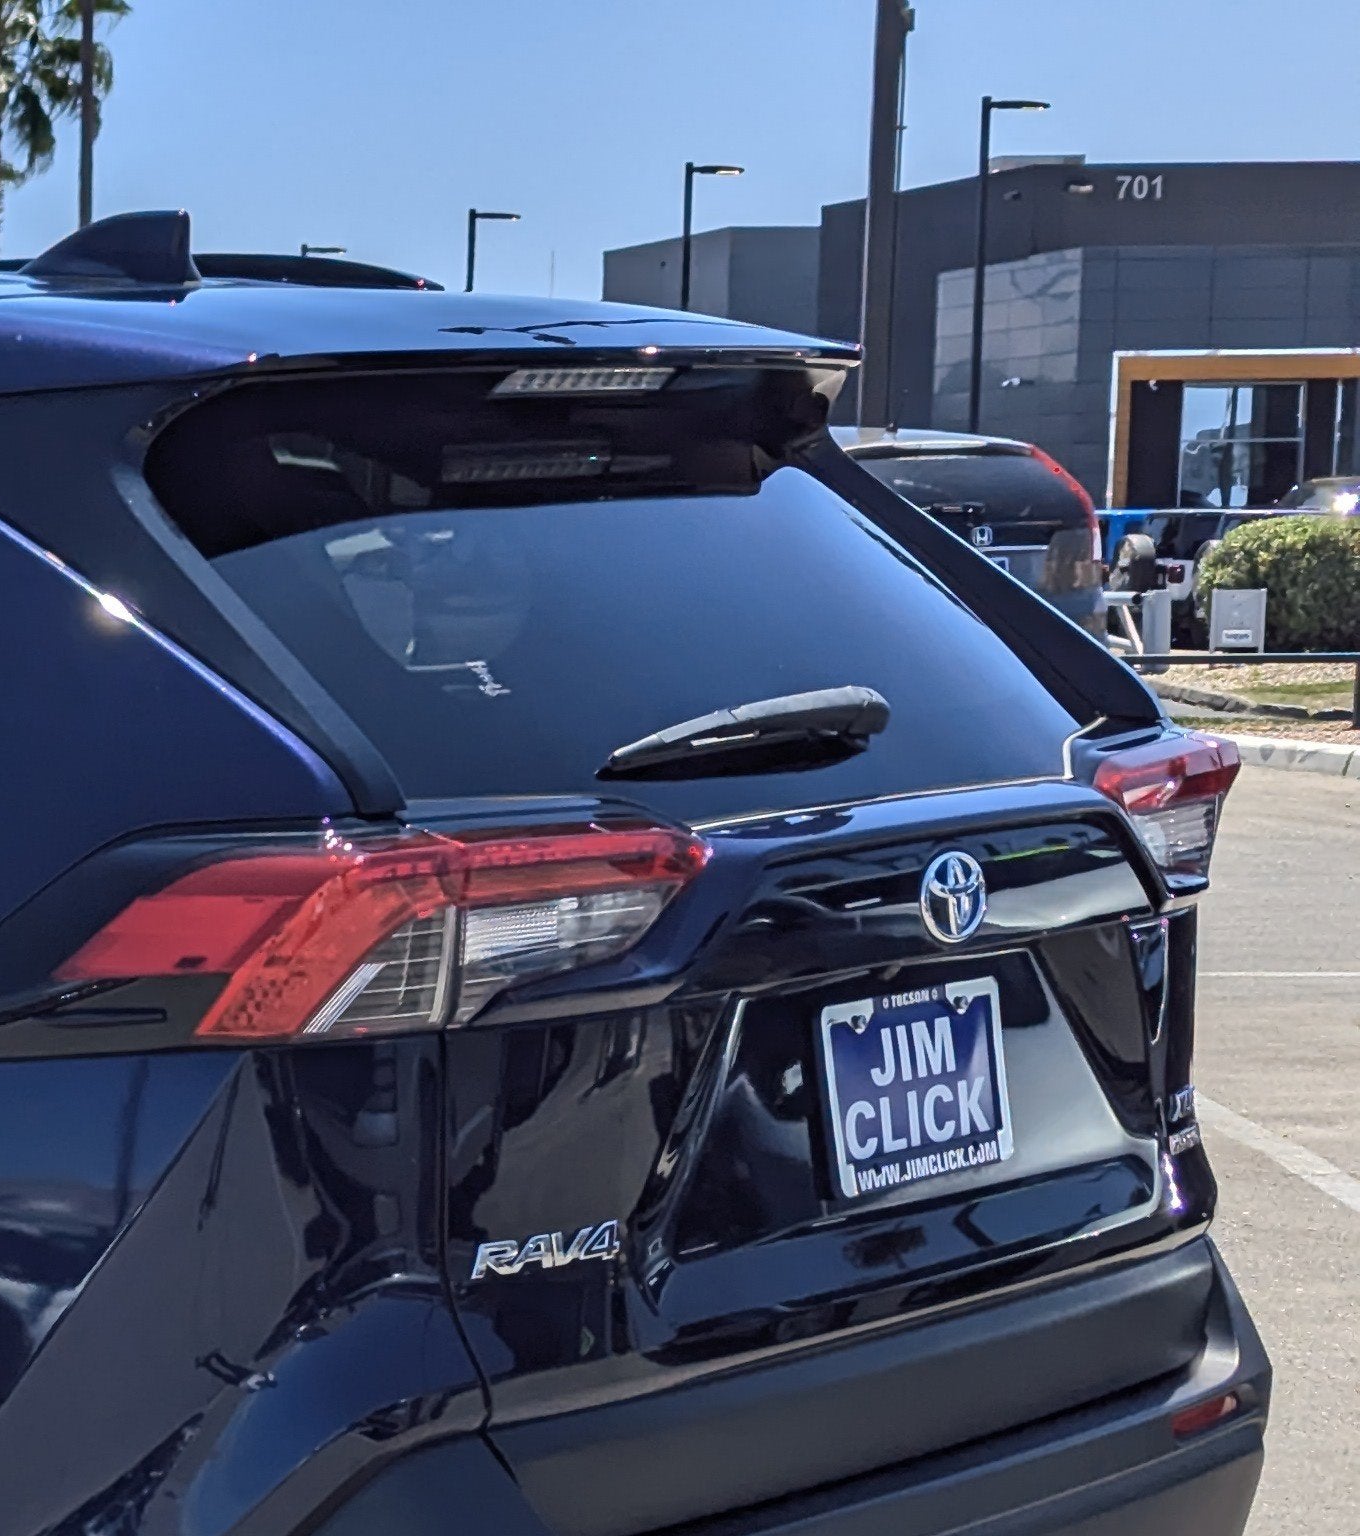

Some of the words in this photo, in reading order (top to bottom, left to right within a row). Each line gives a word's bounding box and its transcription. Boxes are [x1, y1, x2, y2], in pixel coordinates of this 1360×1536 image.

[1116, 175, 1163, 199] 701
[890, 988, 930, 1008] TUCSON
[870, 1017, 956, 1086] JIM
[845, 1076, 990, 1160] CLICK
[857, 1140, 999, 1191] WWW.JIMCLICK.COM
[470, 1219, 621, 1280] RAV4
